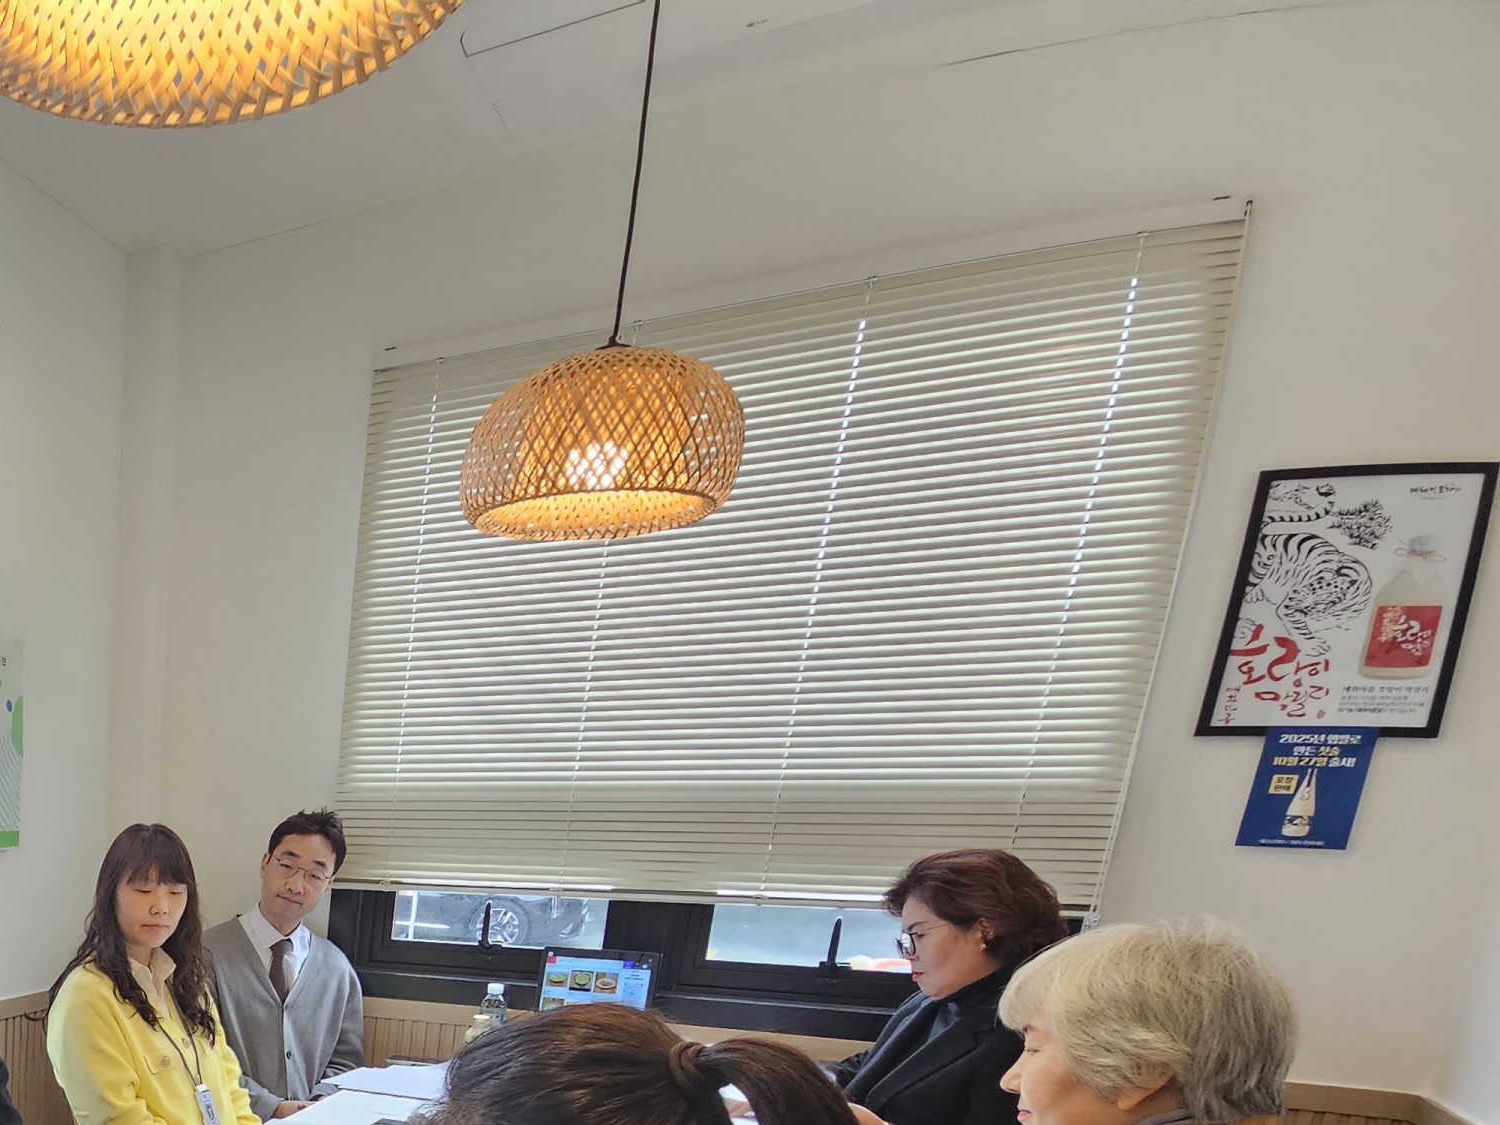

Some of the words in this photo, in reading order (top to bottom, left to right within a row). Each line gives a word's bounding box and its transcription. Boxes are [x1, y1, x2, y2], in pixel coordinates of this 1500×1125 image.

[1279, 734, 1326, 744] 2025년
[1273, 757, 1299, 766] 10월
[1299, 757, 1328, 767] 27일
[1328, 757, 1357, 767] 출시!
